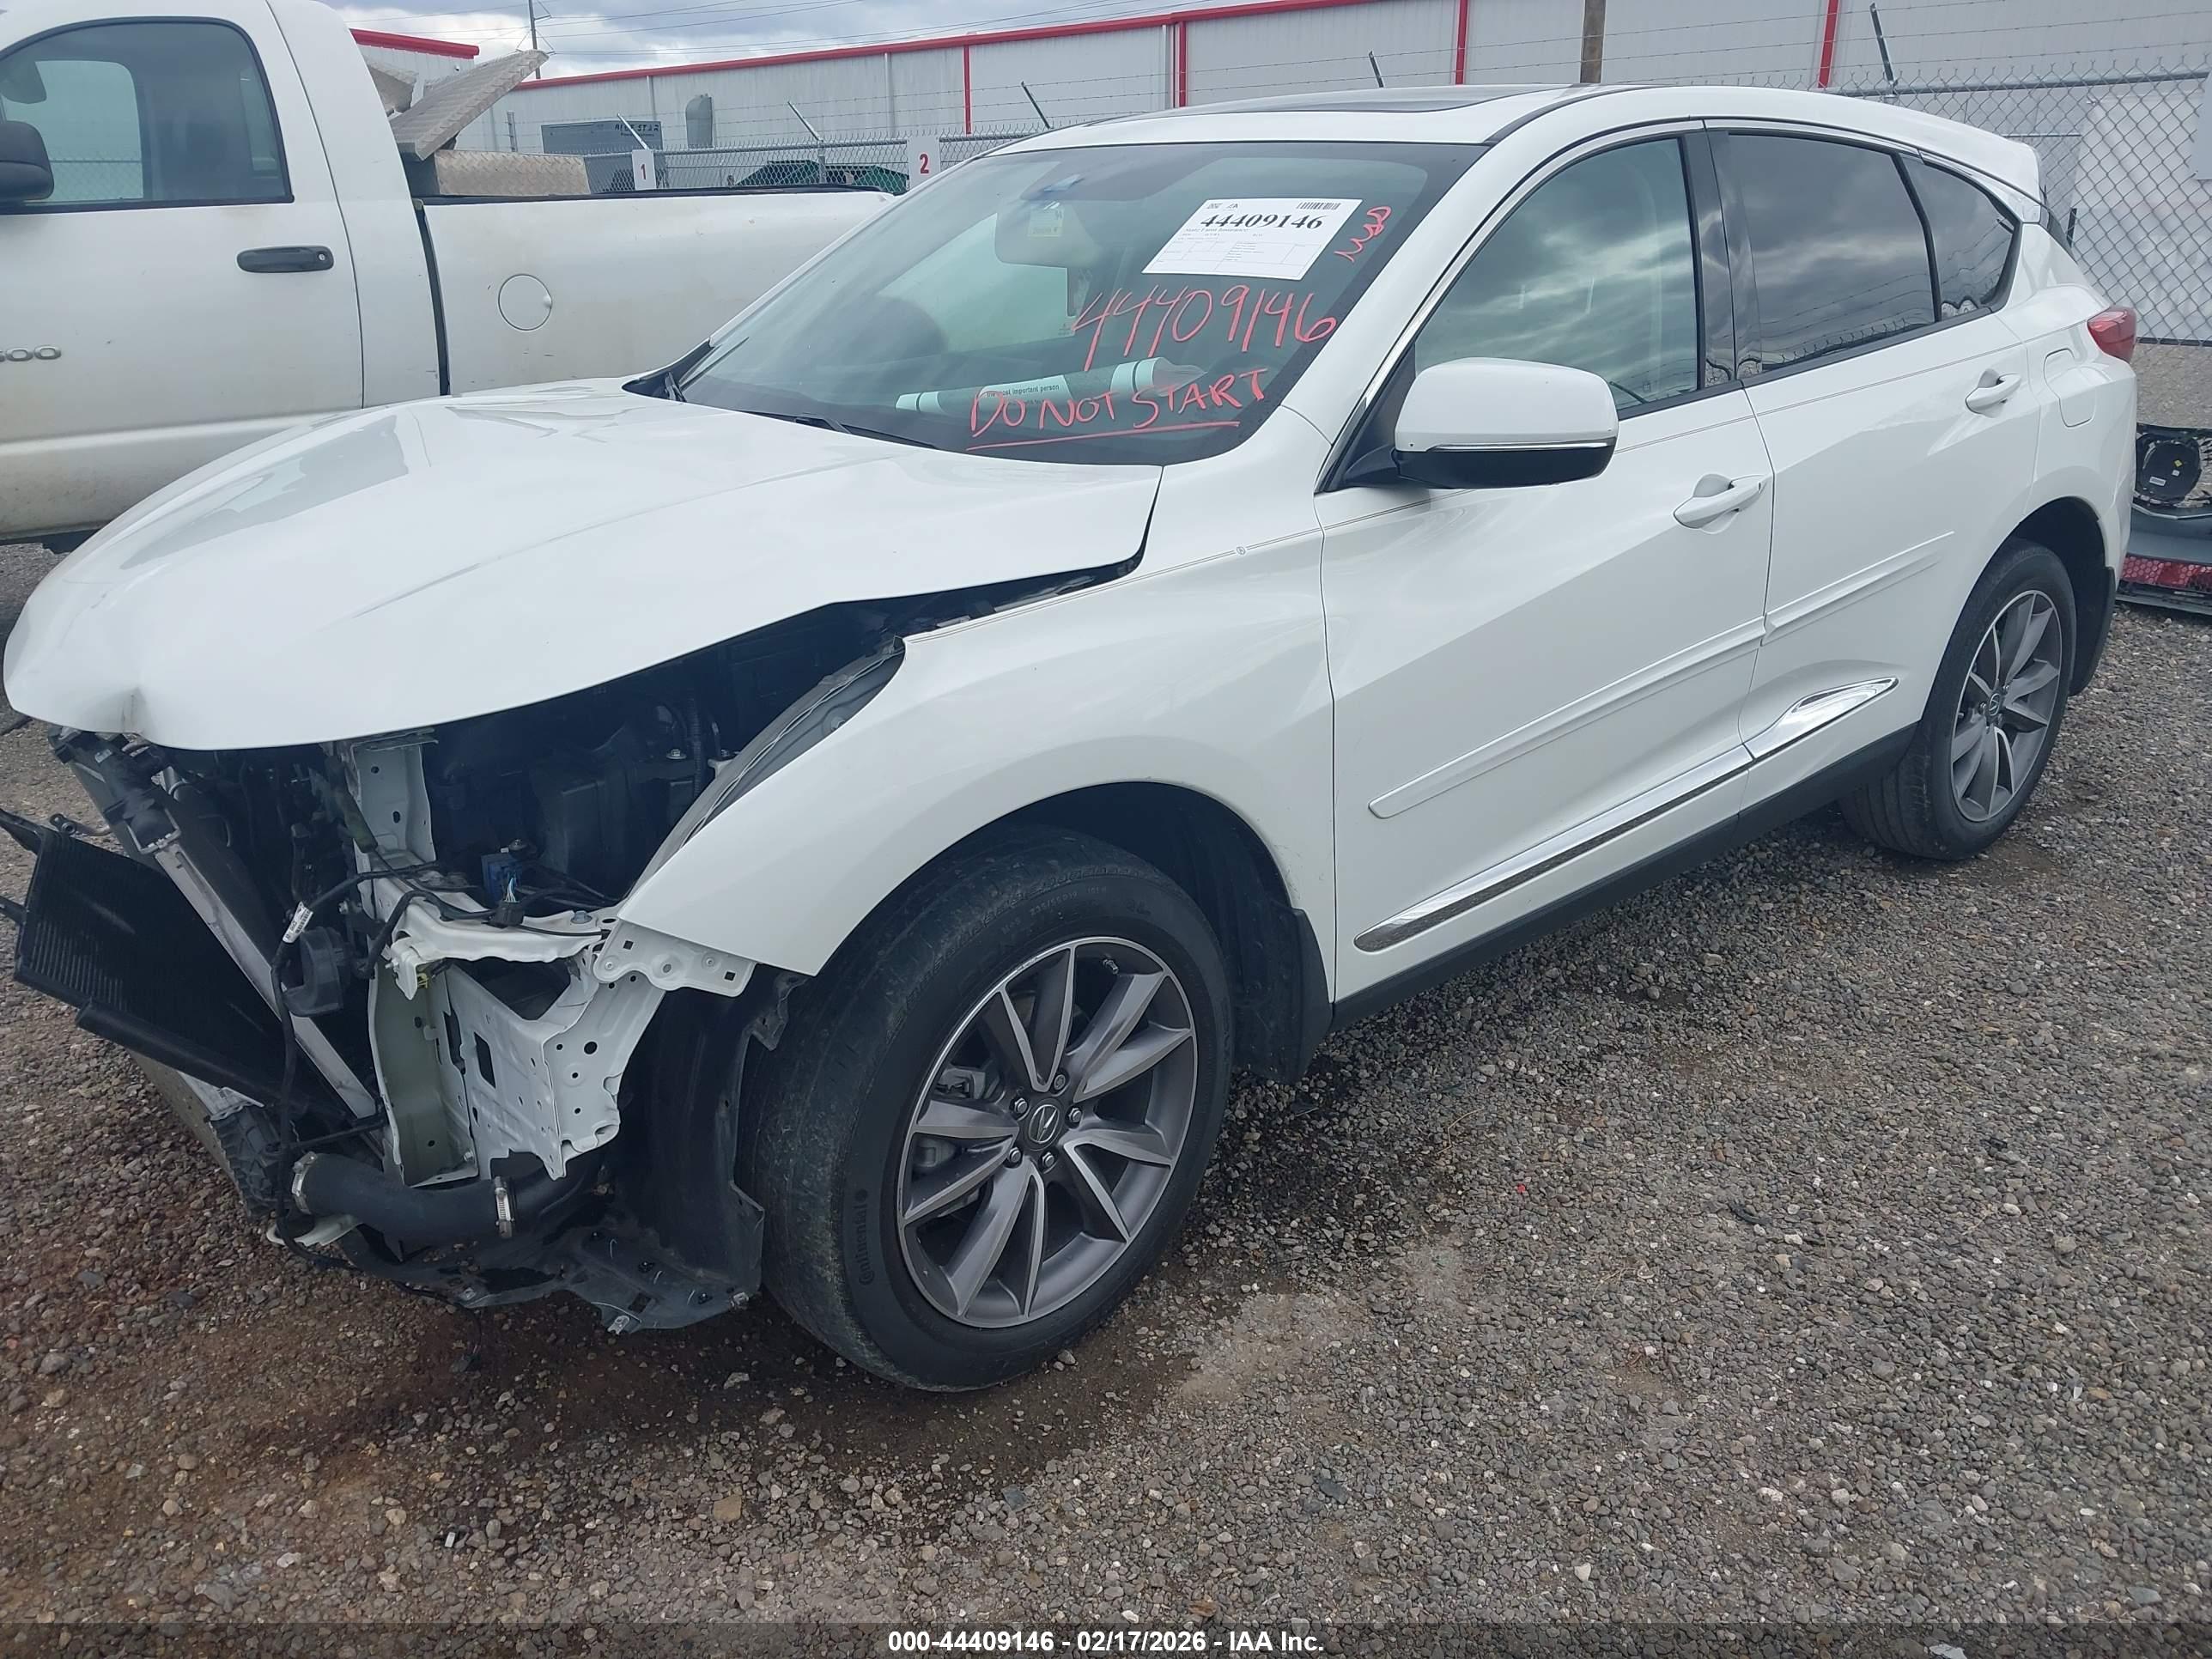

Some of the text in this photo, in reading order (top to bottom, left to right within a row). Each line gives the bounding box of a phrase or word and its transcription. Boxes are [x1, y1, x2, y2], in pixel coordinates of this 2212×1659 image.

[641, 164, 647, 179] 1
[920, 154, 929, 173] 2
[1200, 214, 1327, 229] 44409146
[1072, 284, 1337, 371] 44409146
[0, 345, 61, 362] 00
[1012, 386, 1038, 395] important
[1040, 384, 1060, 393] person
[969, 368, 1267, 438] DO NOT START
